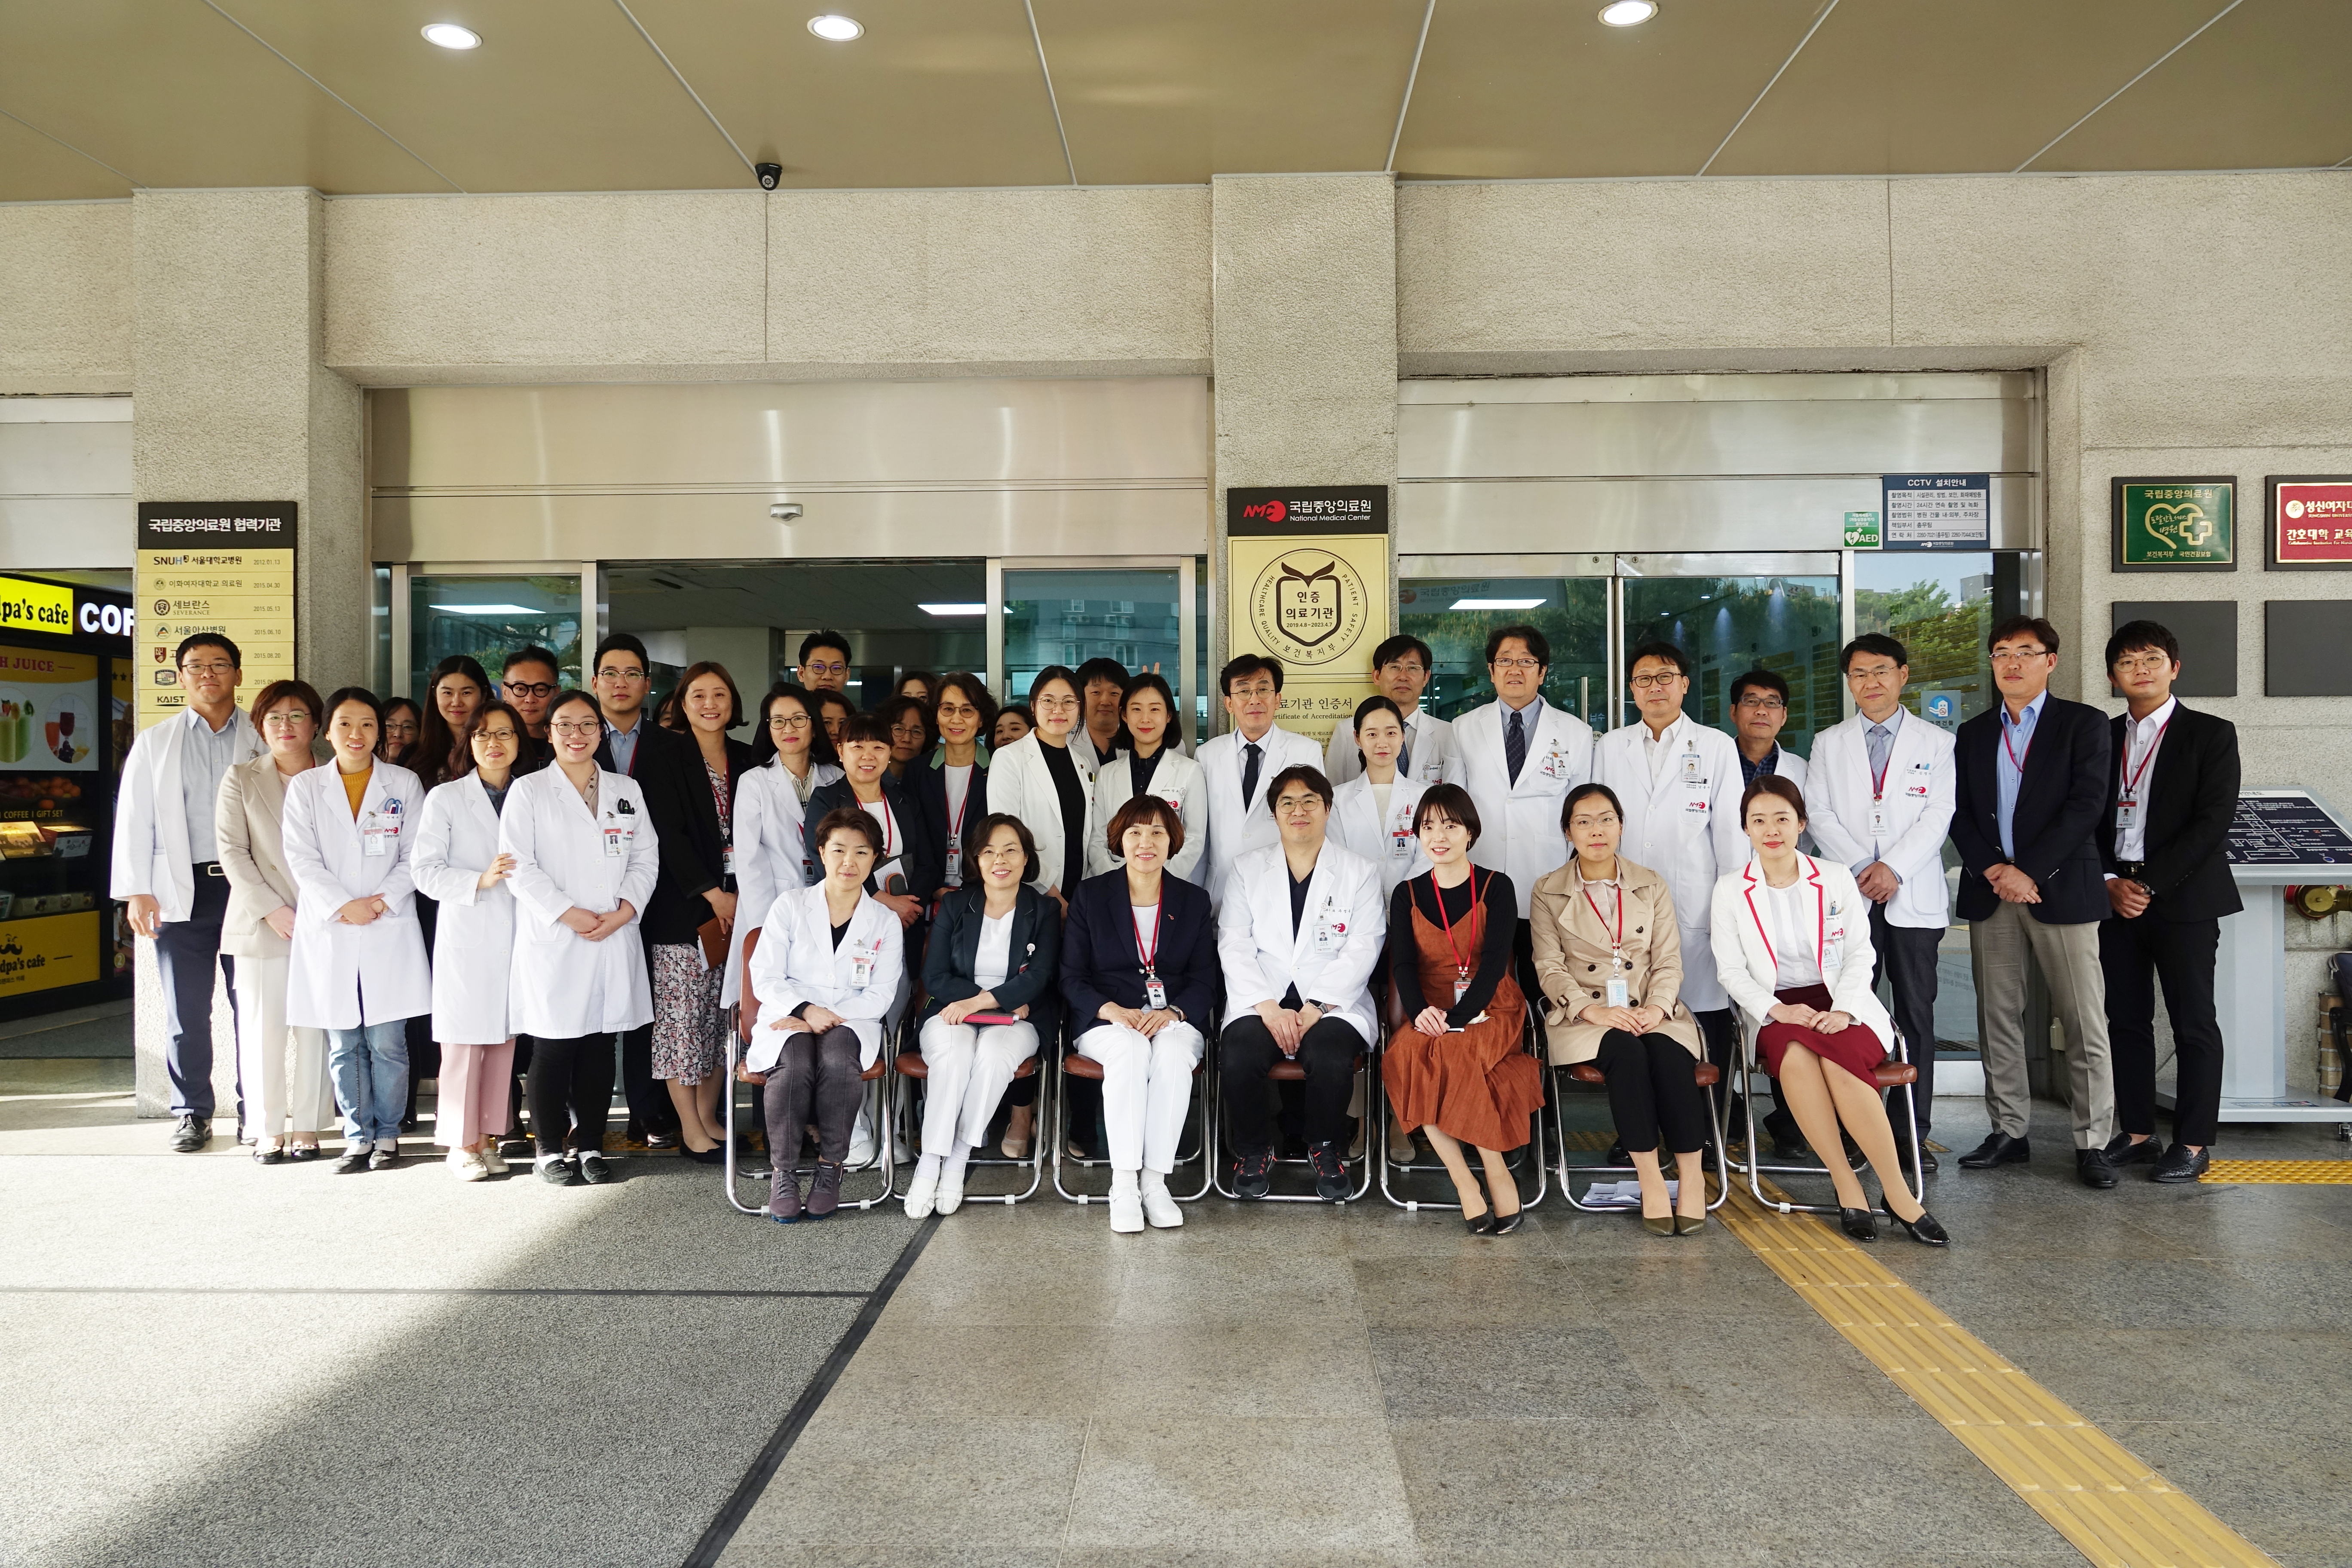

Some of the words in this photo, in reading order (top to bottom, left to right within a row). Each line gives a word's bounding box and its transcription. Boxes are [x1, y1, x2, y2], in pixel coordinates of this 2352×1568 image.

[2144, 489, 2213, 499] 국립중앙의료원
[1243, 500, 1286, 522] NMC
[1290, 499, 1371, 514] 국립중앙의료원
[149, 518, 231, 532] 국립중앙의료원
[234, 518, 282, 532] 협력기관
[2160, 524, 2178, 535] 병원
[2286, 529, 2329, 540] 간호대학
[153, 557, 182, 565] SNUH
[191, 556, 242, 565] 서울대학교병원
[1259, 575, 1275, 617] HEALTHCARE
[1342, 574, 1358, 606] PATIENT
[0, 597, 34, 623] pa's
[38, 603, 69, 625] cafe
[173, 600, 210, 609] 세브란스
[1286, 607, 1334, 619] 의료기관
[1262, 621, 1280, 645] QUALITY
[1342, 613, 1358, 642] SAFETY
[1283, 643, 1336, 659] 보건복지부
[13, 658, 55, 672] JUICE
[1279, 698, 1314, 710] 료기관
[1319, 698, 1352, 710] 인증서
[27, 954, 45, 968] cafe
